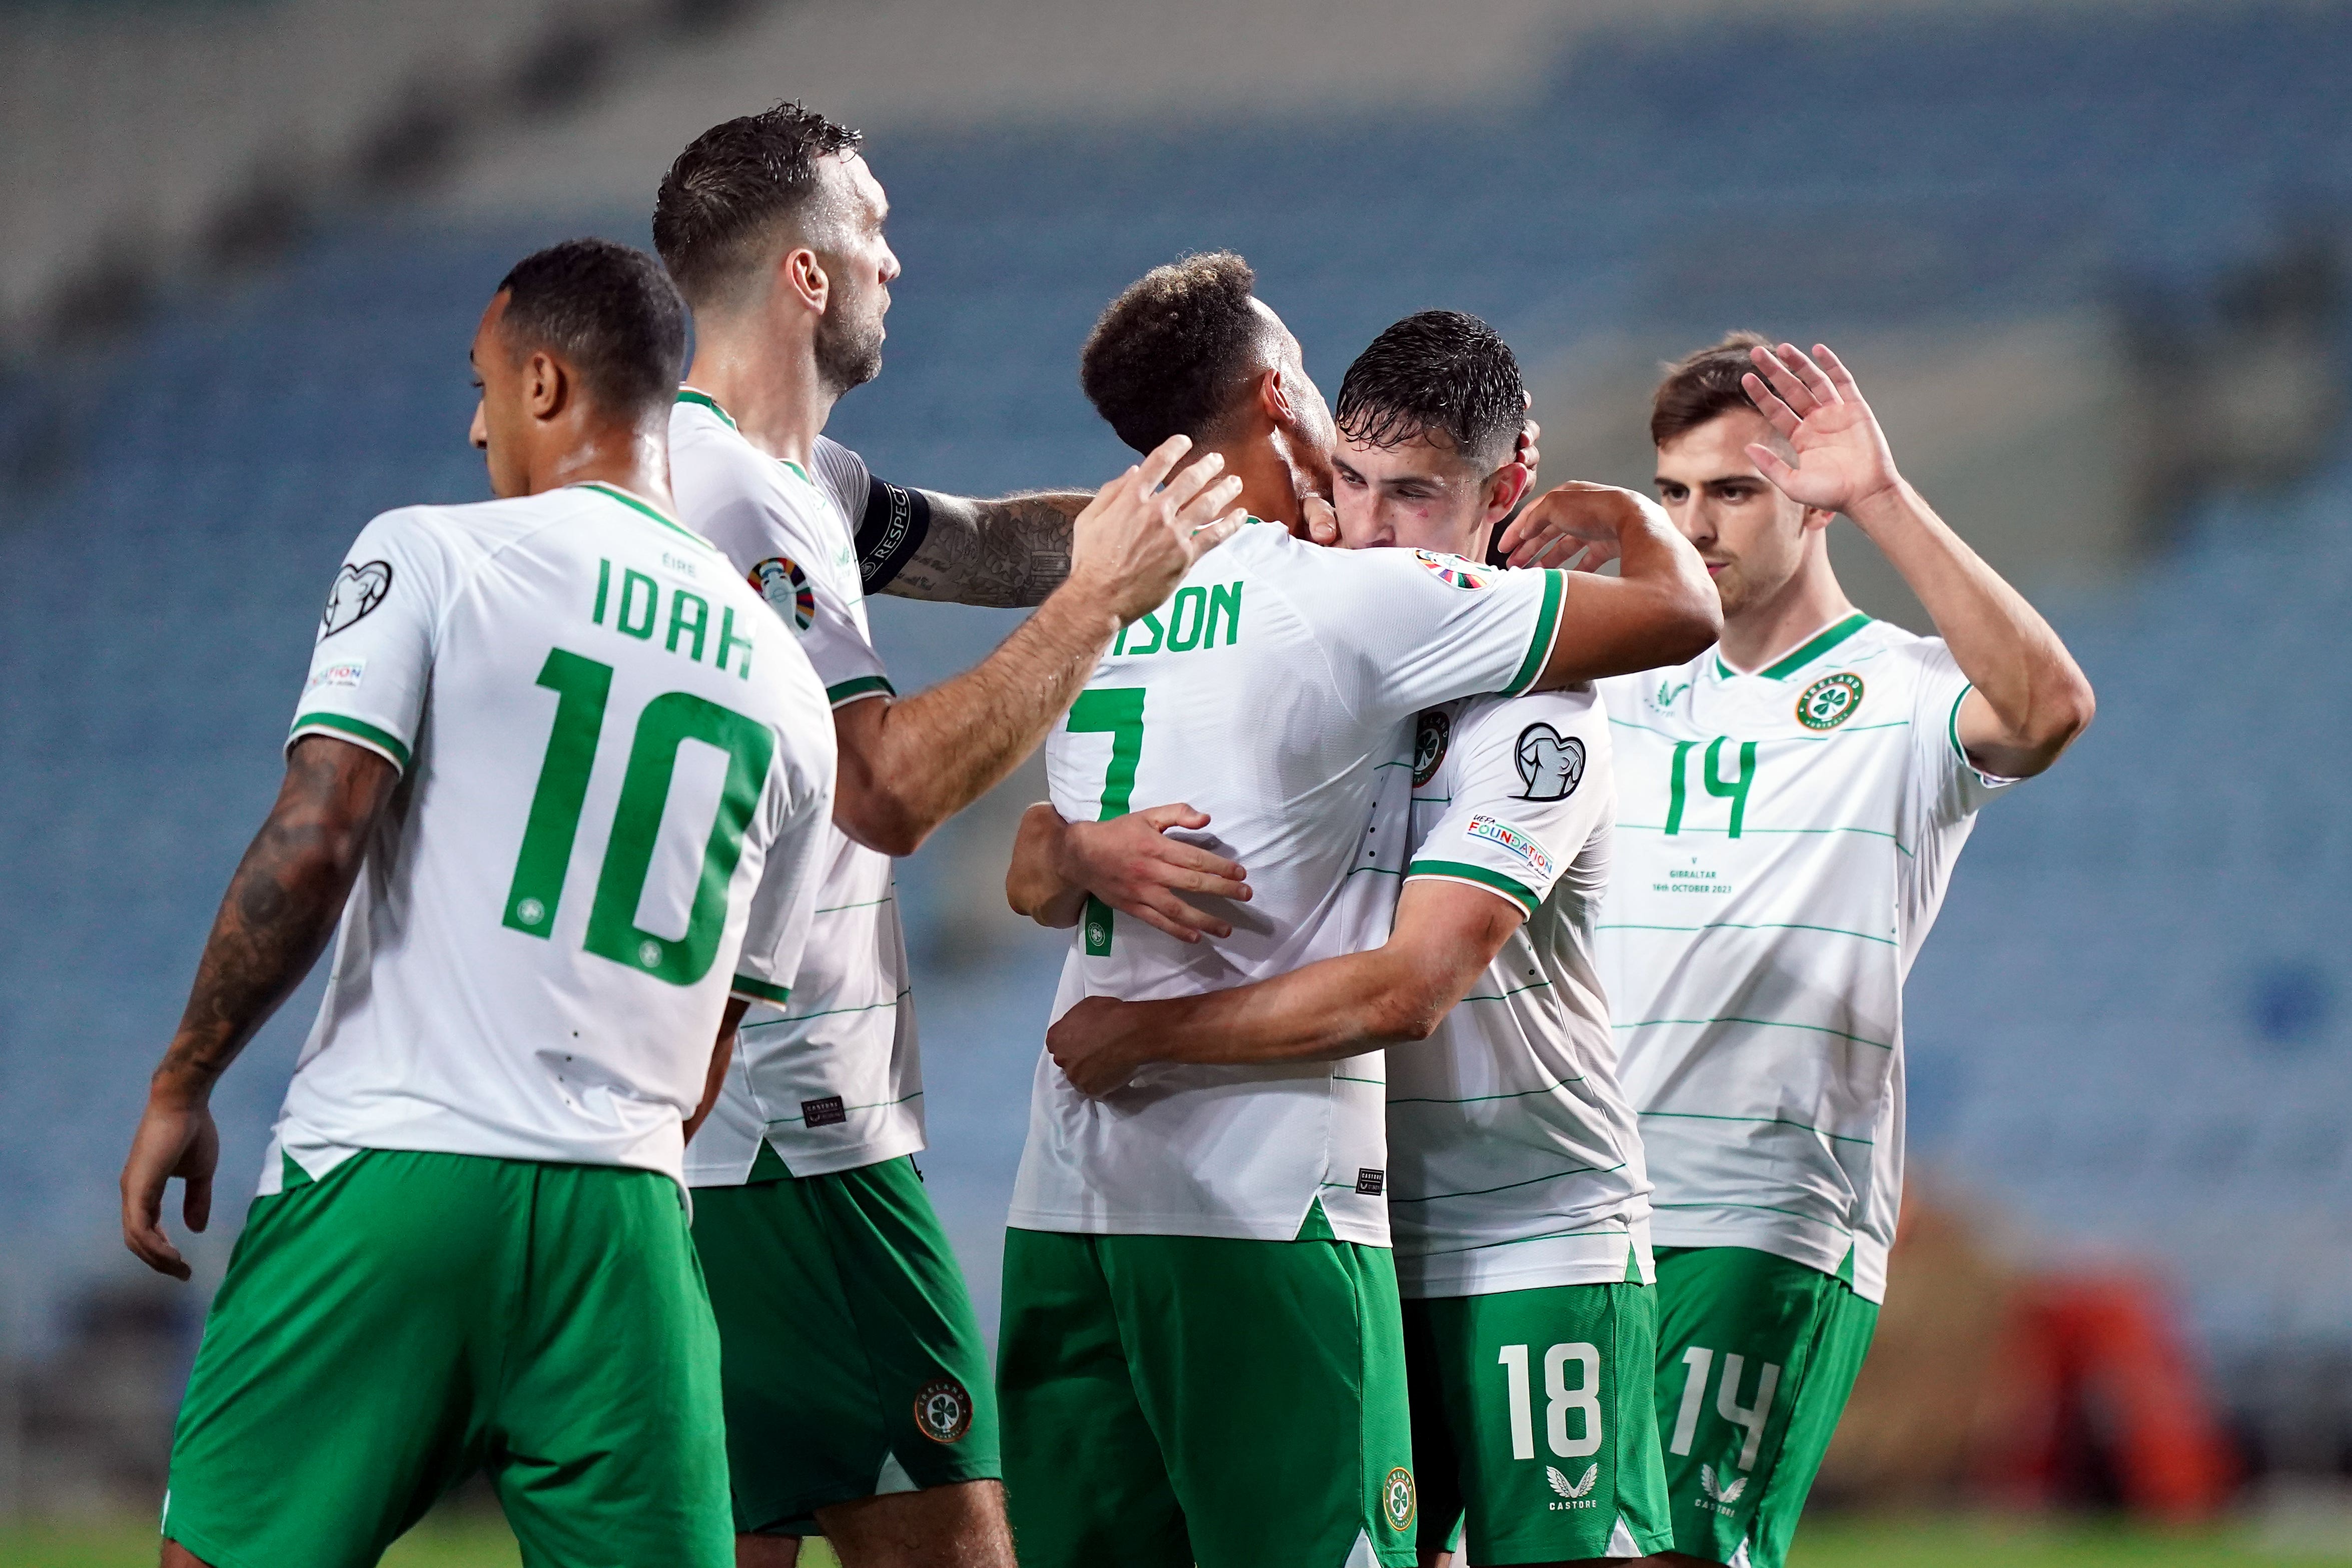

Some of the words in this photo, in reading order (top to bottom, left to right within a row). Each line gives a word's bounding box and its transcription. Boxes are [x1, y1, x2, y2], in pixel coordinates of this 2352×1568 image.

[874, 483, 907, 558] RESPECT
[592, 558, 752, 681] IDAH
[1803, 674, 1860, 700] IRELAND
[1665, 736, 1758, 839] 14
[501, 646, 776, 988] 10
[1066, 687, 1146, 957] 7
[1473, 814, 1495, 825] UEFA
[1468, 822, 1552, 874] FOUNDATION
[1670, 870, 1717, 879] GIBRALTAR
[1672, 885, 1710, 893] OCTOBER
[1712, 886, 1732, 894] 2023
[919, 1384, 964, 1405] IRELAND
[1497, 1342, 1603, 1460] 18
[1669, 1346, 1781, 1472] 14
[1386, 1472, 1412, 1491] IRELAND
[1549, 1499, 1597, 1510] CASTORE
